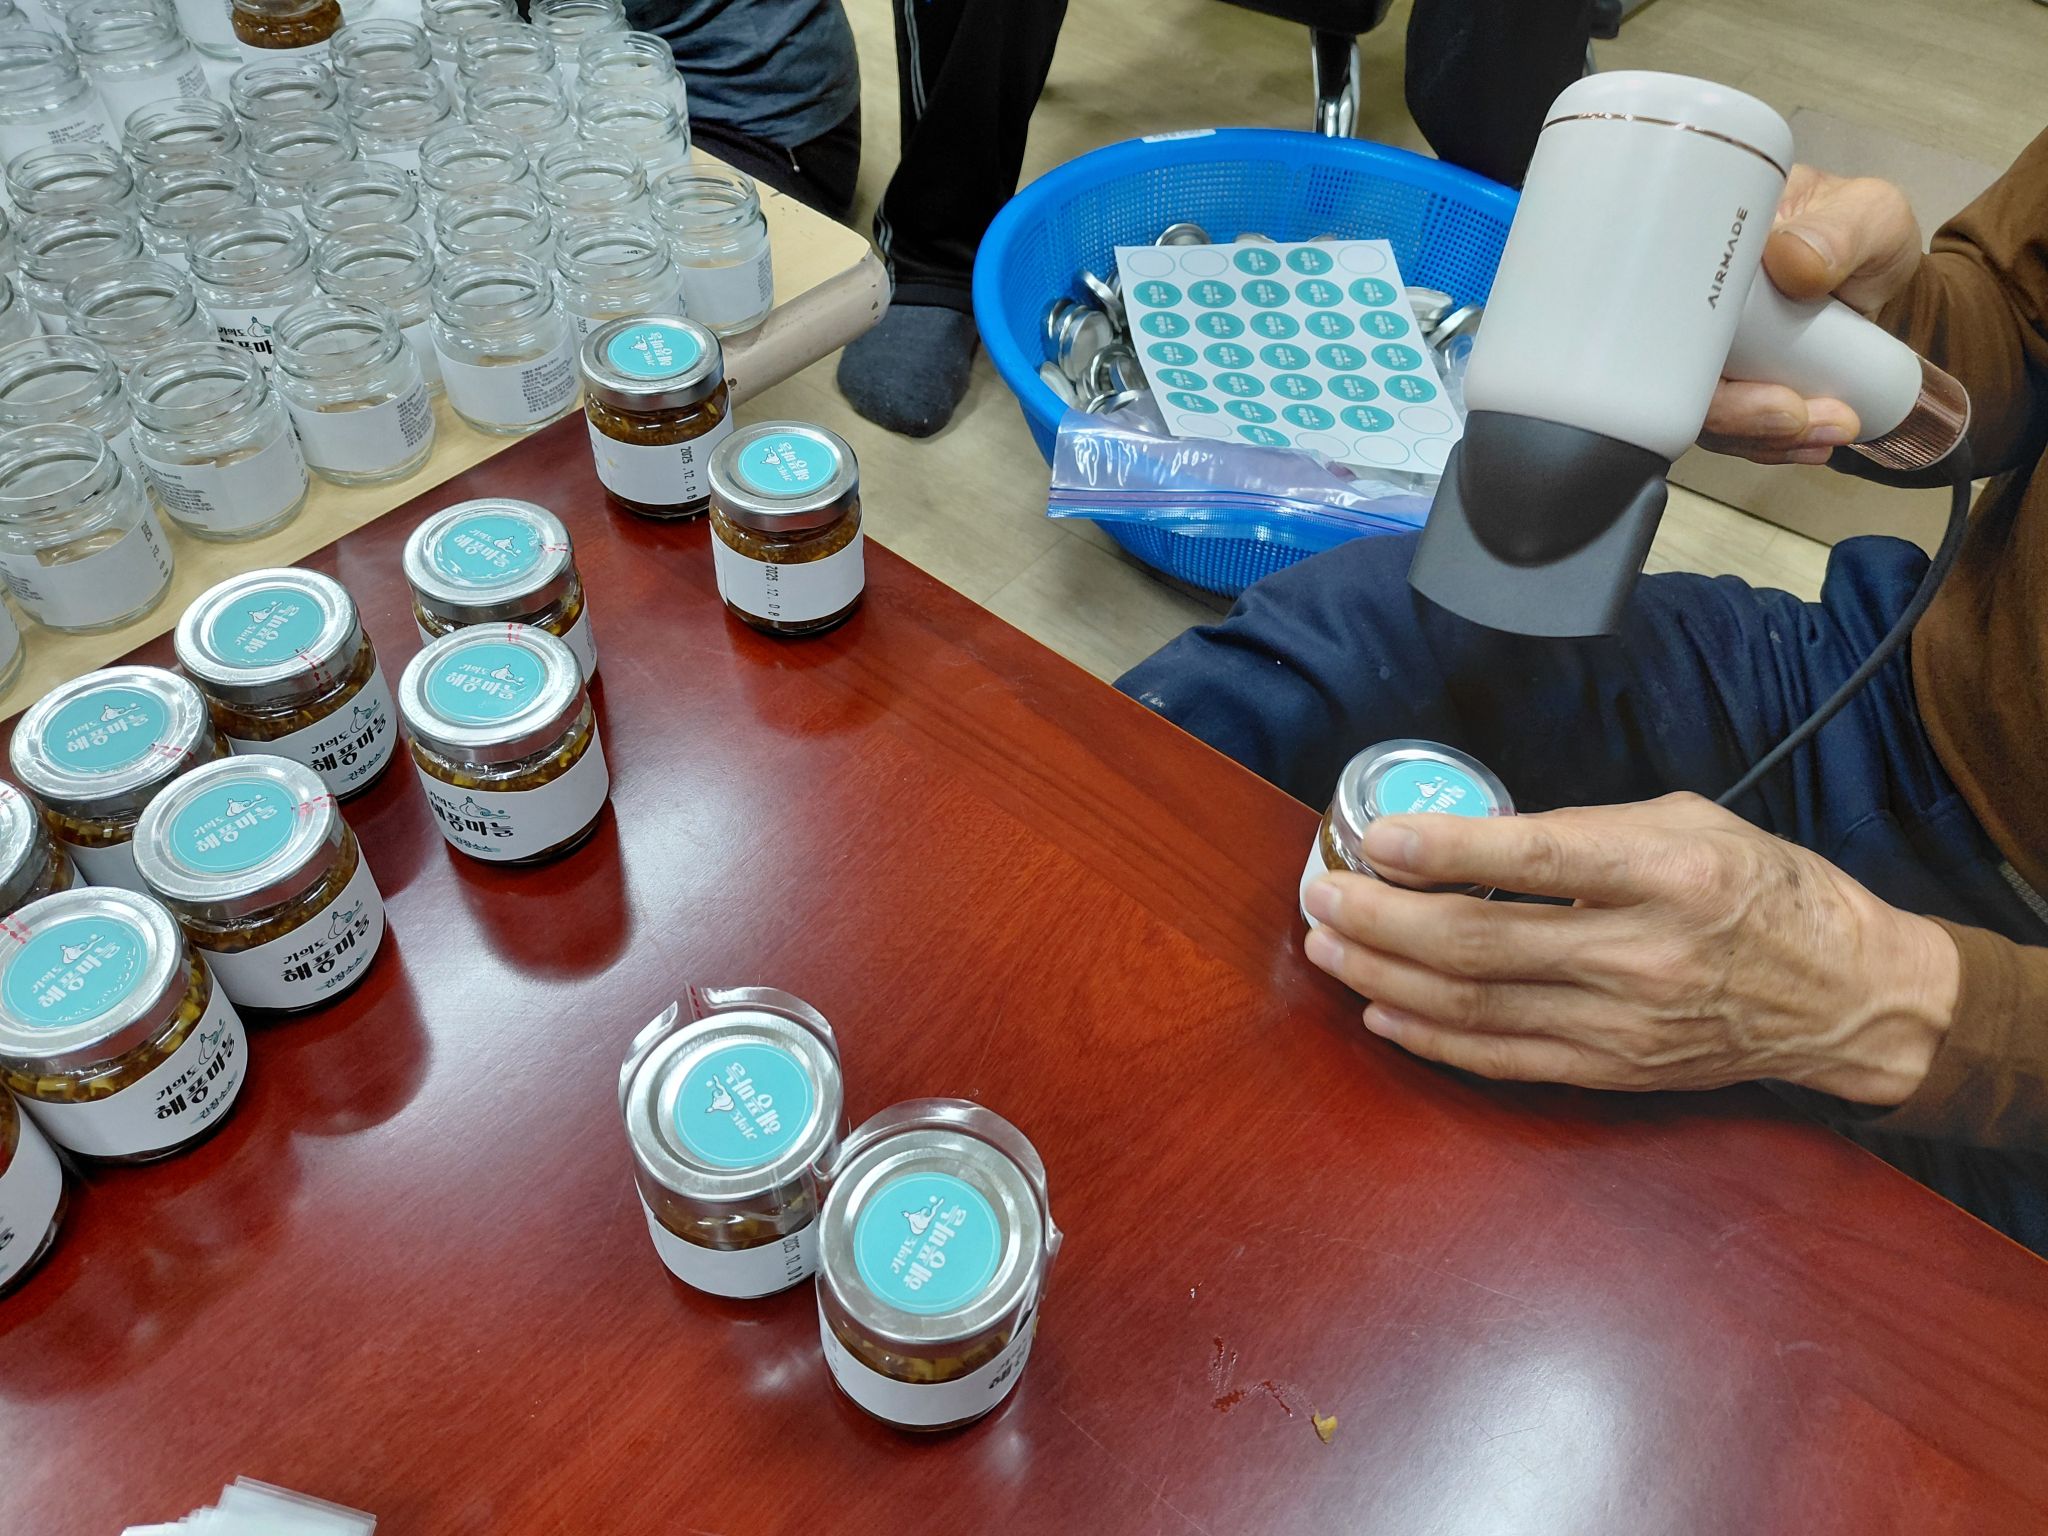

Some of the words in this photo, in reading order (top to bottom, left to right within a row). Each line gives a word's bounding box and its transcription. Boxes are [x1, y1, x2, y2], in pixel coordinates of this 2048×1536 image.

[1707, 206, 1748, 310] AIRMADE
[777, 441, 810, 482] 해풍마늘
[454, 534, 510, 568] 해풍마늘
[243, 603, 301, 654] 해풍마늘
[445, 672, 515, 701] 해풍마늘
[66, 713, 149, 753] 해풍마늘
[310, 713, 387, 773] 해풍마늘
[311, 730, 350, 755] 가의도
[192, 815, 226, 838] 가의도
[194, 804, 279, 853] 해풍마늘
[280, 914, 370, 984] 해풍마늘
[282, 938, 328, 965] 가의도
[37, 941, 121, 1009] 해풍마늘
[154, 1032, 235, 1121] 해풍마늘
[156, 1065, 199, 1101] 가의도
[725, 1061, 781, 1136] 해풍마늘
[729, 1108, 758, 1141] 가의도
[889, 1236, 918, 1275] 가의도
[902, 1203, 968, 1291] 해풍마늘
